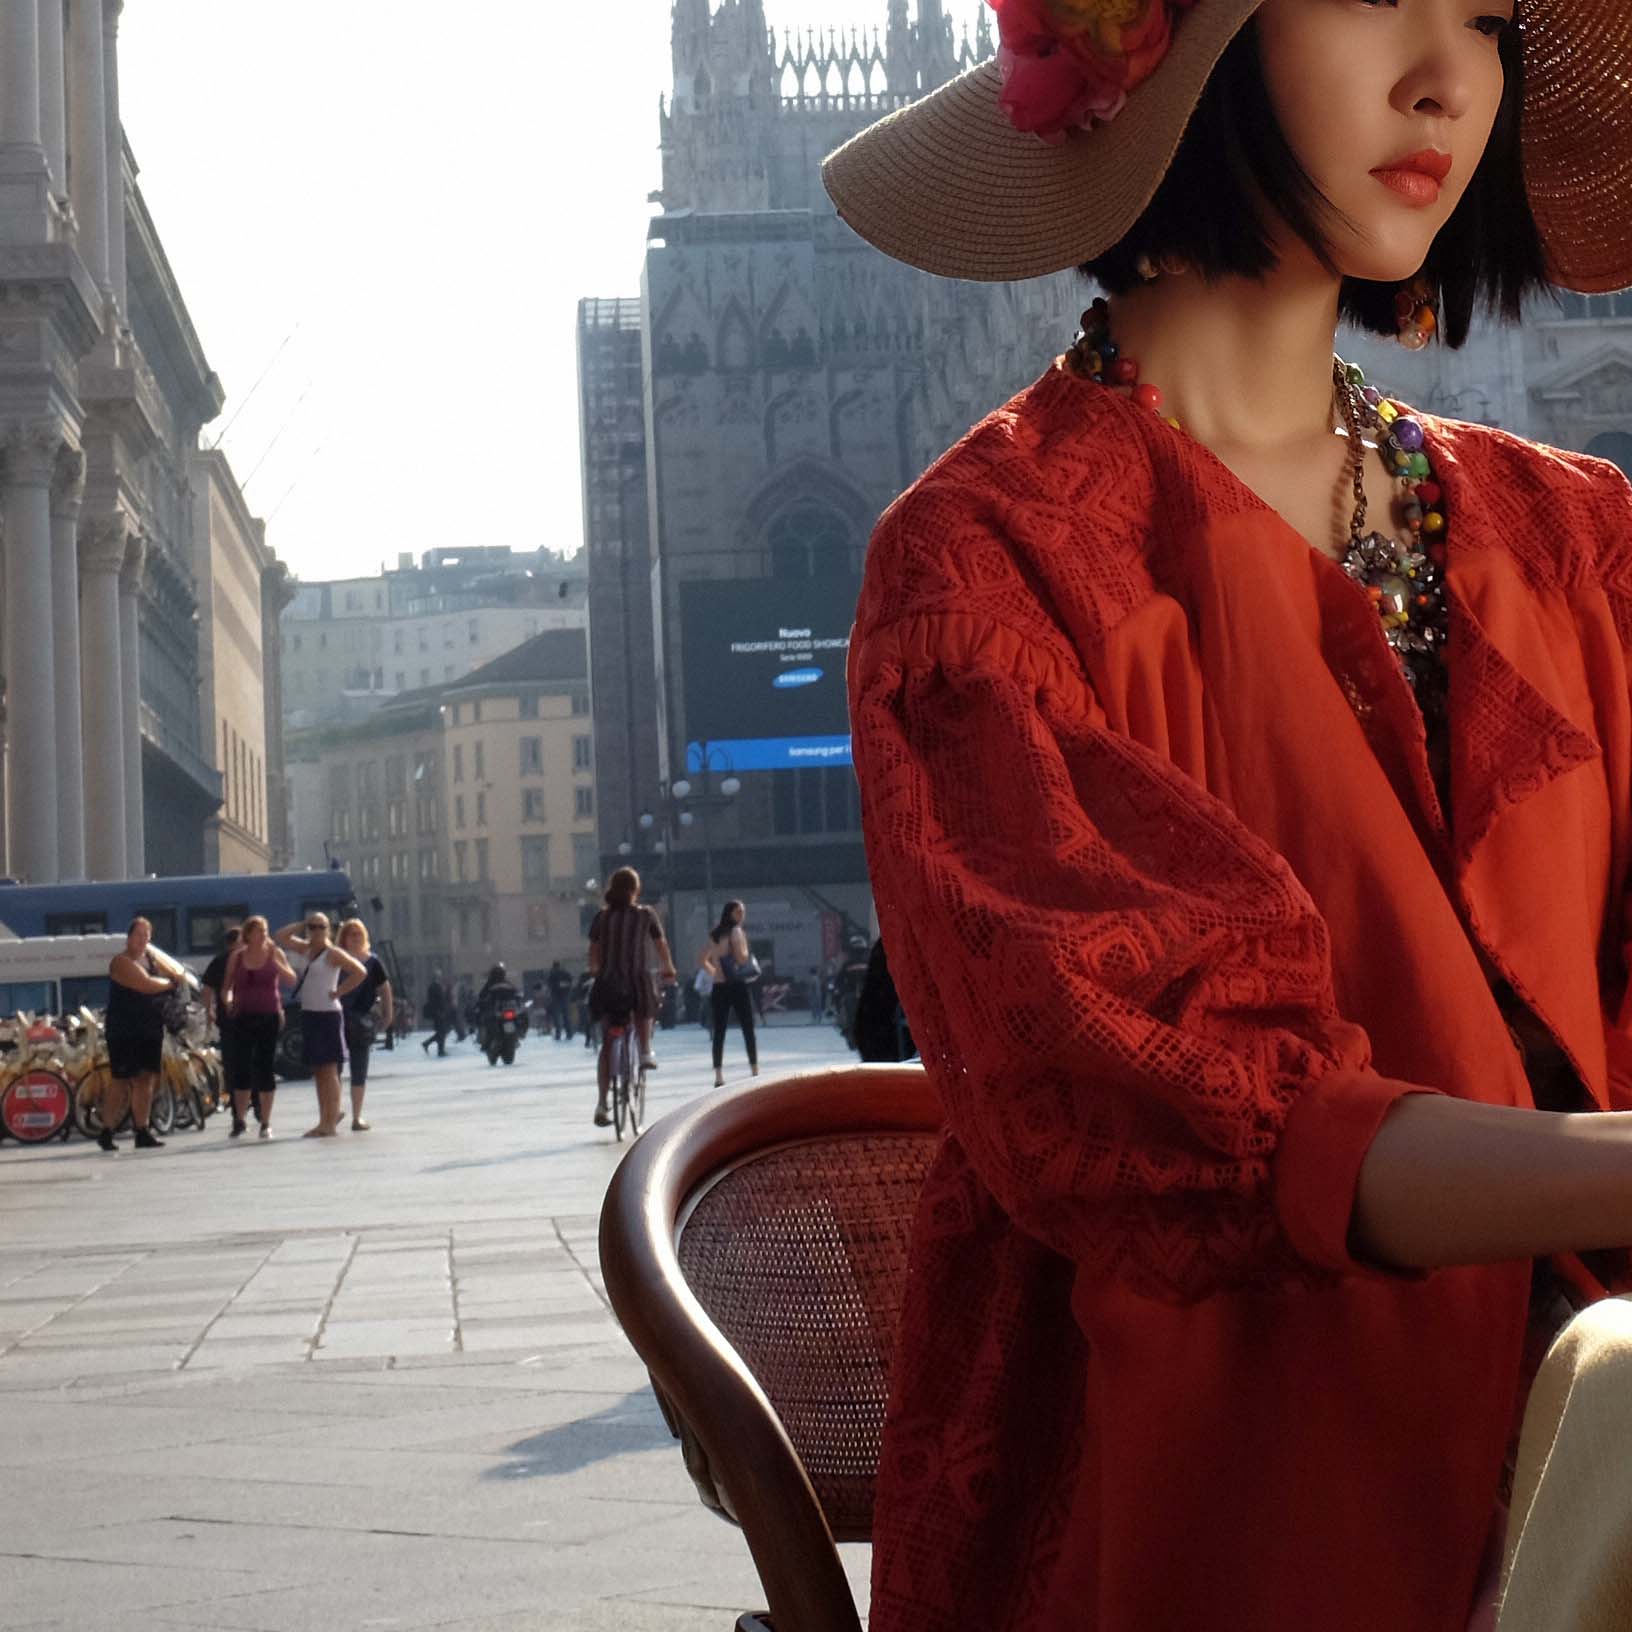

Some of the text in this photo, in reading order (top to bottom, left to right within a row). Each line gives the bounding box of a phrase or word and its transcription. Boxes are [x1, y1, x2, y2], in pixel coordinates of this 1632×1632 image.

[779, 628, 811, 638] Nuovo
[788, 639, 812, 649] FOOD
[789, 747, 828, 757] Samsung
